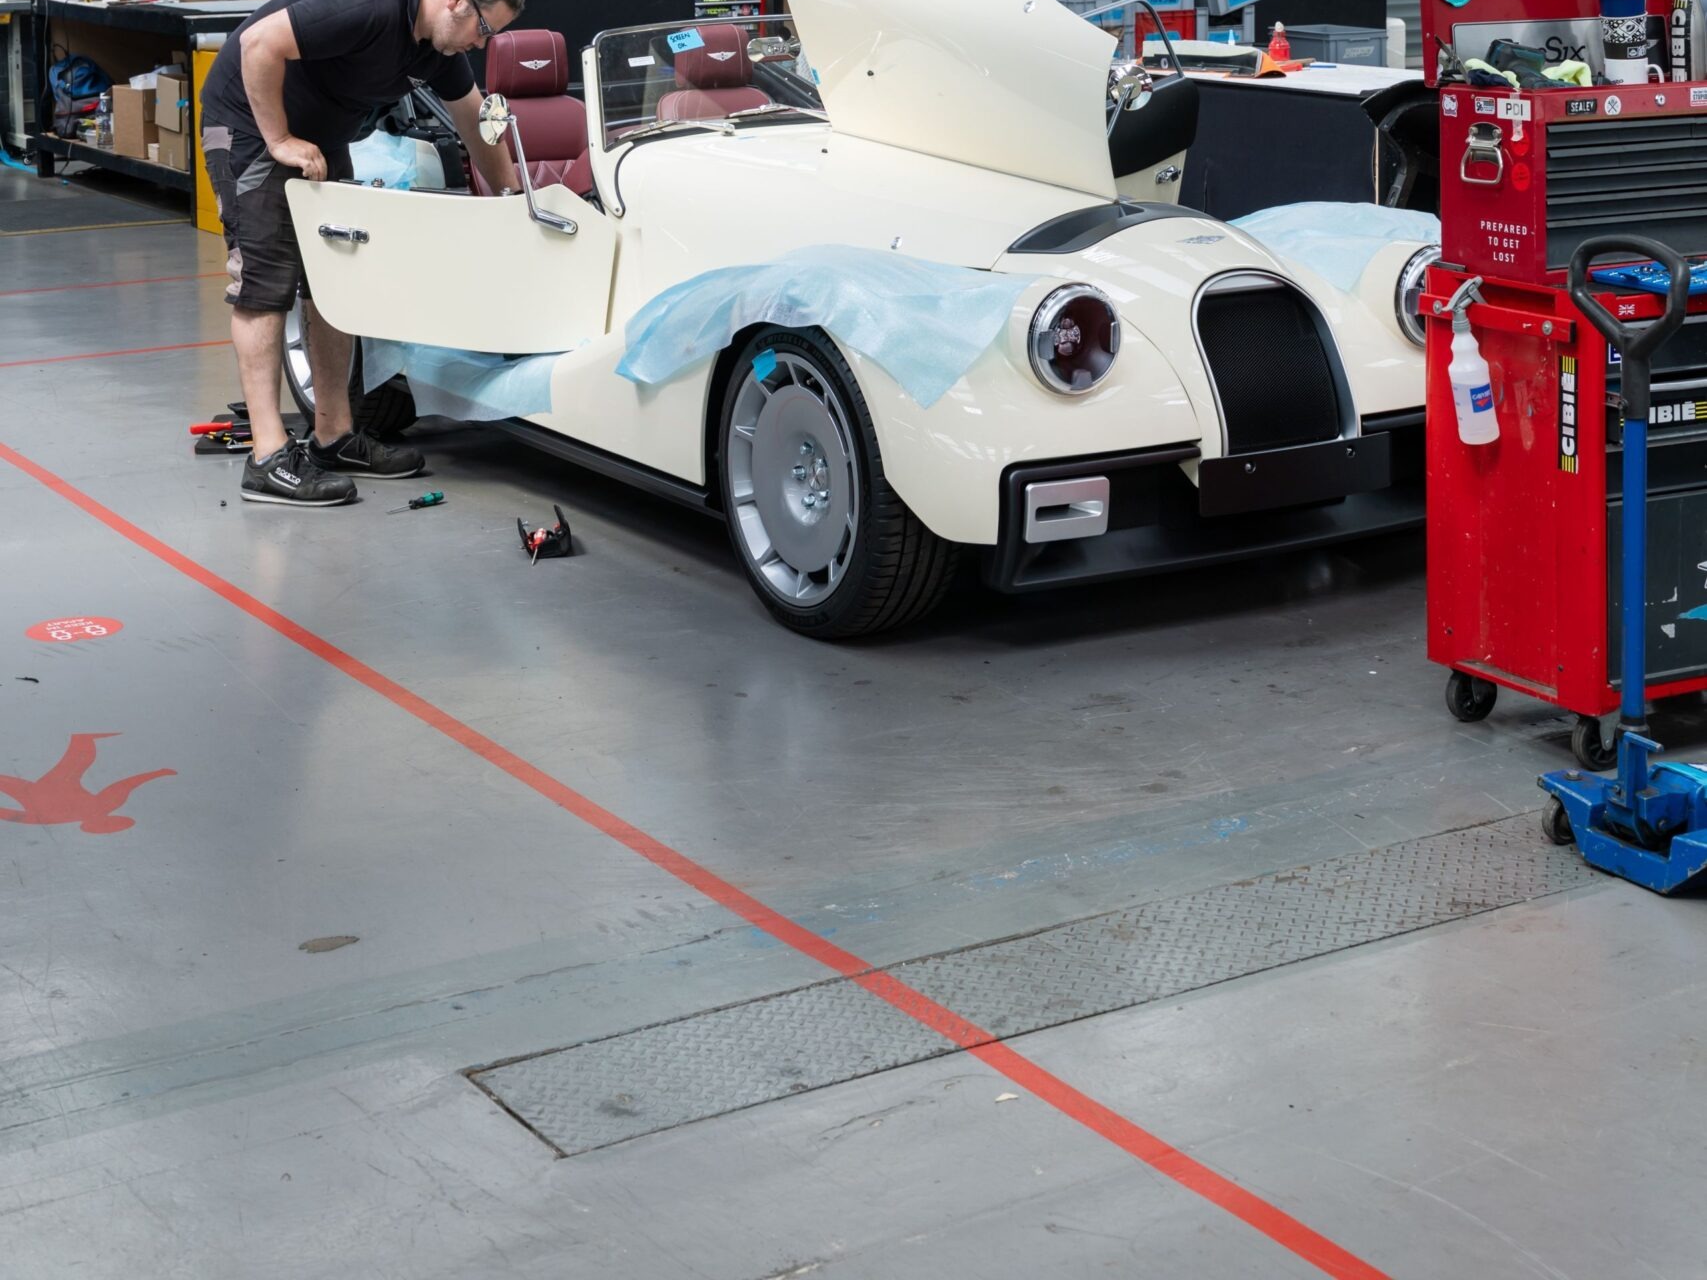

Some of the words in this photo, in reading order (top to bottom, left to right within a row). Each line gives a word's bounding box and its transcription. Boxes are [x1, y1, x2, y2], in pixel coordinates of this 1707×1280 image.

[1505, 102, 1524, 116] PDI
[1570, 101, 1594, 113] SEALEY
[1480, 220, 1528, 236] PREPARED
[1488, 236, 1499, 247] TO
[1503, 238, 1520, 249] GET
[1493, 251, 1515, 263] LOST
